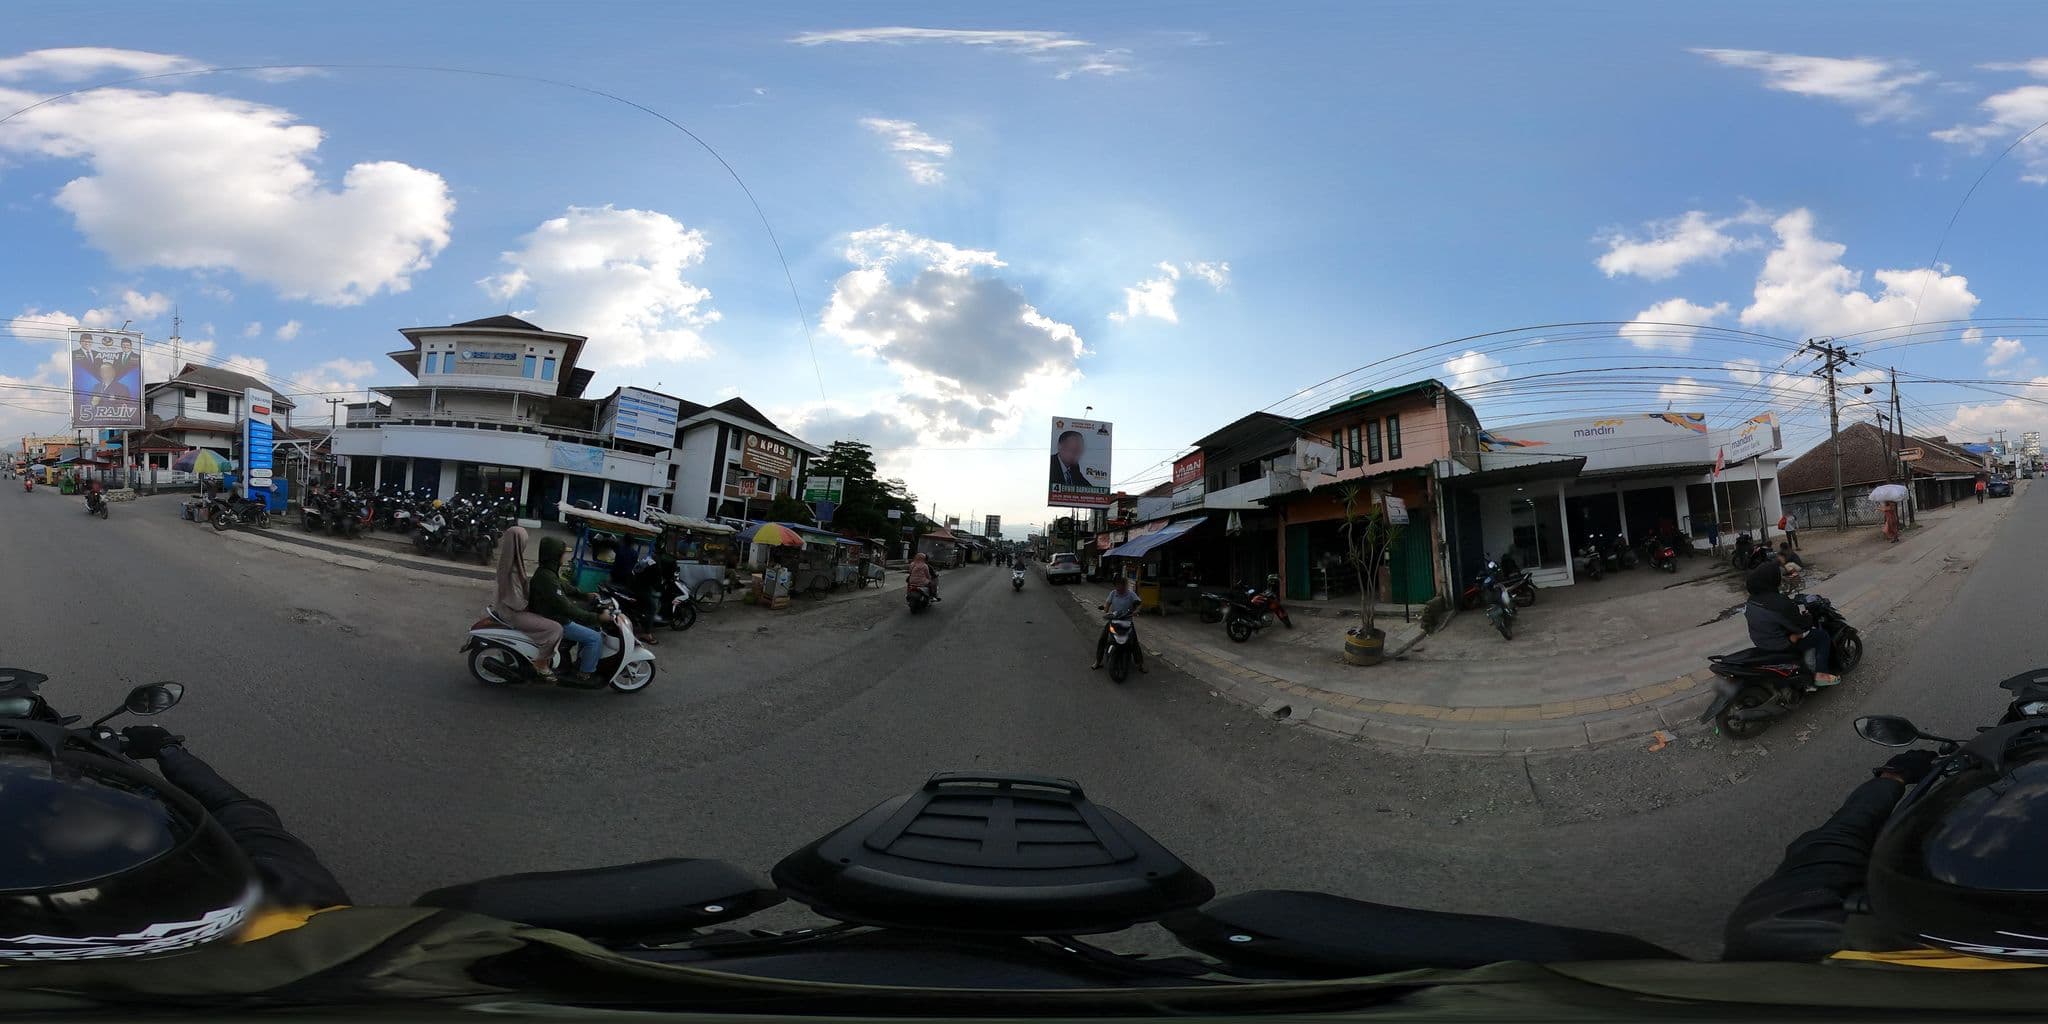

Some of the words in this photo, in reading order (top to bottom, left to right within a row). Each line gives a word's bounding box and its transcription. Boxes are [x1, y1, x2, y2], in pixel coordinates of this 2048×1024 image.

[95, 352, 120, 360] AMIN
[79, 404, 94, 422] 5
[95, 404, 137, 417] RAJIV
[1573, 426, 1615, 437] mandiri
[760, 439, 785, 456] KPBS
[1731, 434, 1753, 449] mandiri
